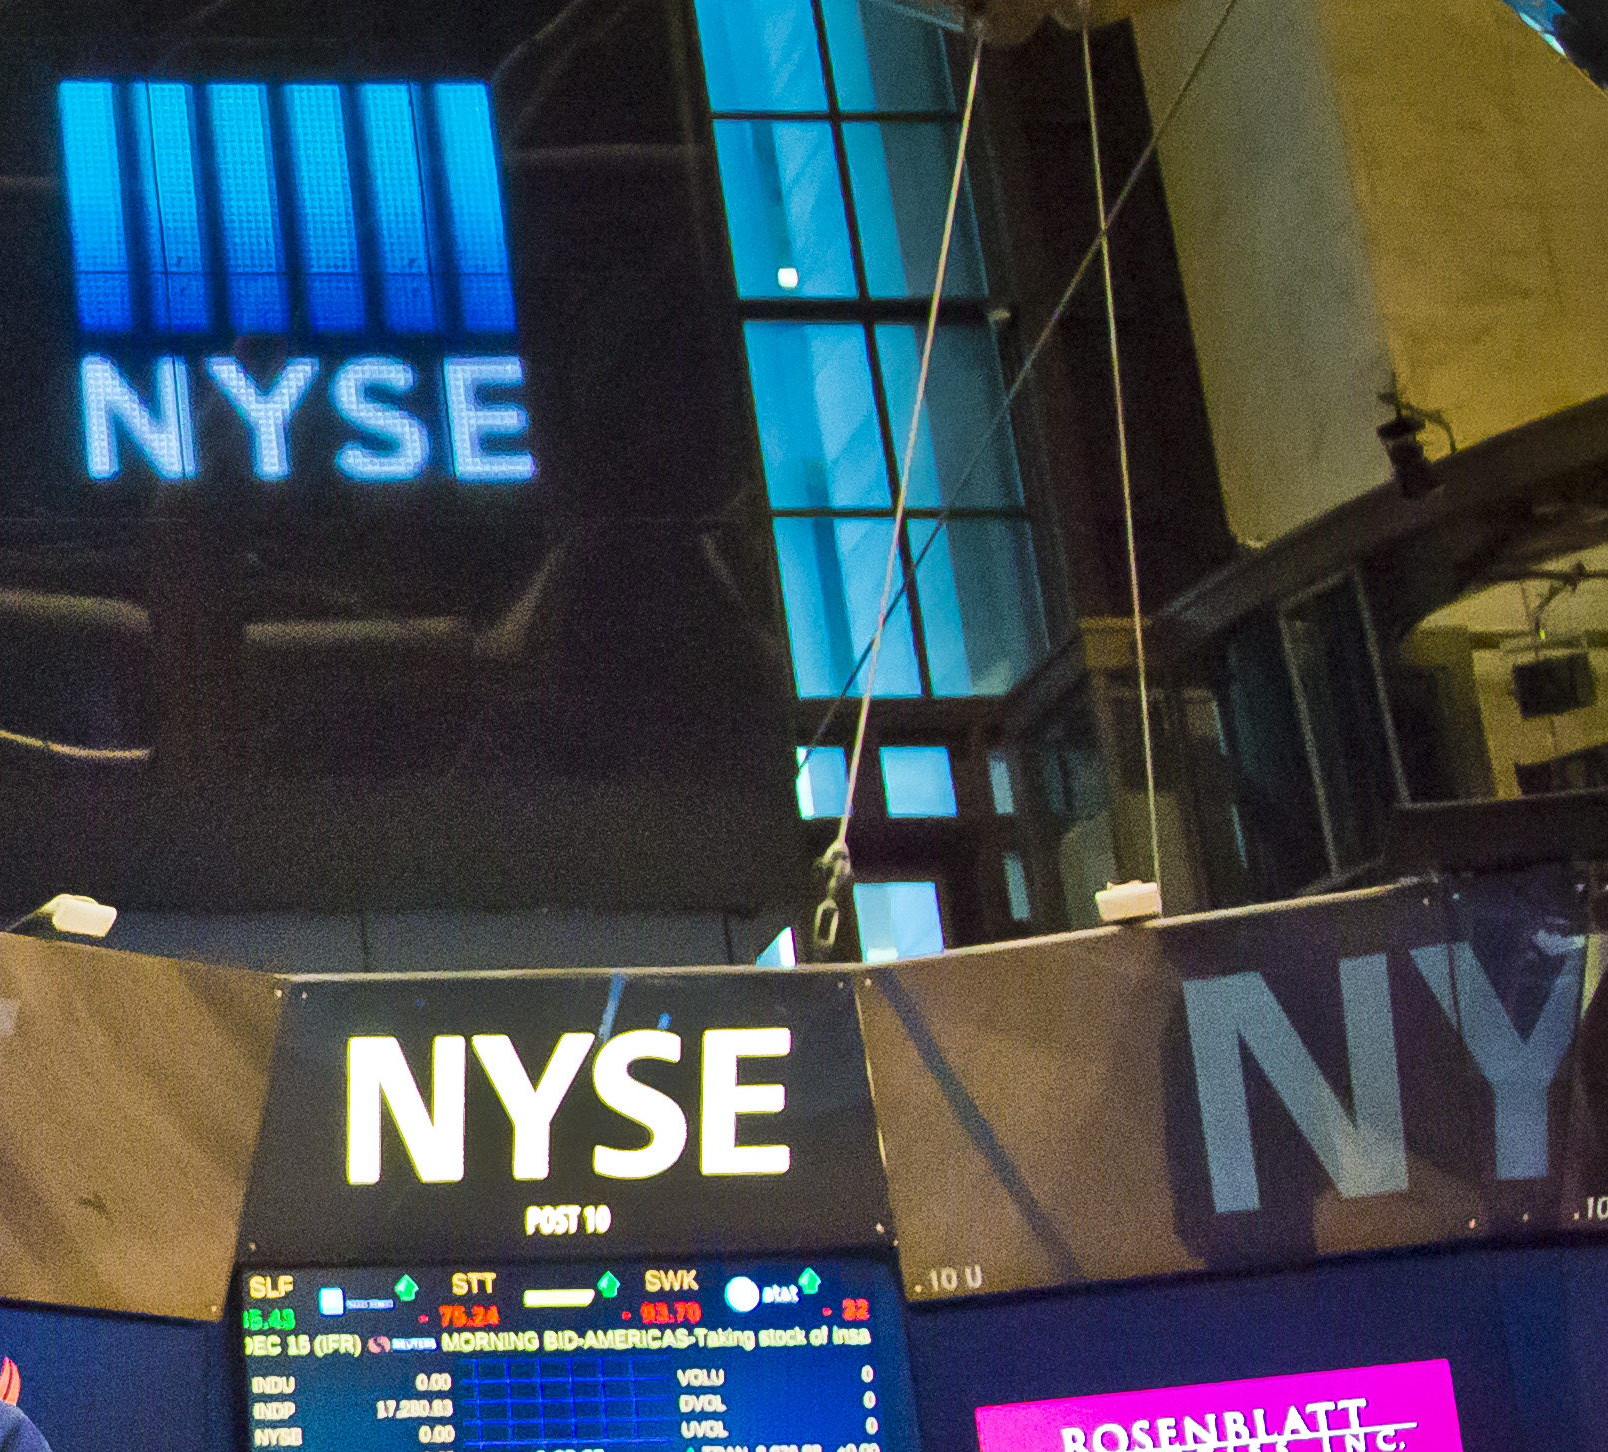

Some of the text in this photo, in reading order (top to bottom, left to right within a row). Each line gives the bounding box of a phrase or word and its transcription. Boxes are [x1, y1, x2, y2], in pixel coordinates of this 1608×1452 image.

[81, 355, 536, 481] NYSE
[346, 1027, 791, 1185] NYSE
[525, 1205, 611, 1235] POST 10
[249, 1275, 294, 1298] SLF
[452, 1272, 497, 1295] STT
[645, 1269, 699, 1292] SWK
[928, 1265, 982, 1291] 10 U
[314, 1333, 362, 1358] (IFR)
[442, 1331, 539, 1353] MORNING
[758, 1326, 807, 1348] stock
[809, 1325, 829, 1347] of
[251, 1373, 452, 1394] INDU 0.00
[677, 1364, 874, 1386] VOLU 0
[679, 1390, 877, 1413] DVOL 0
[254, 1424, 455, 1446] NYSE 0.00
[681, 1416, 879, 1438] UVOL 0
